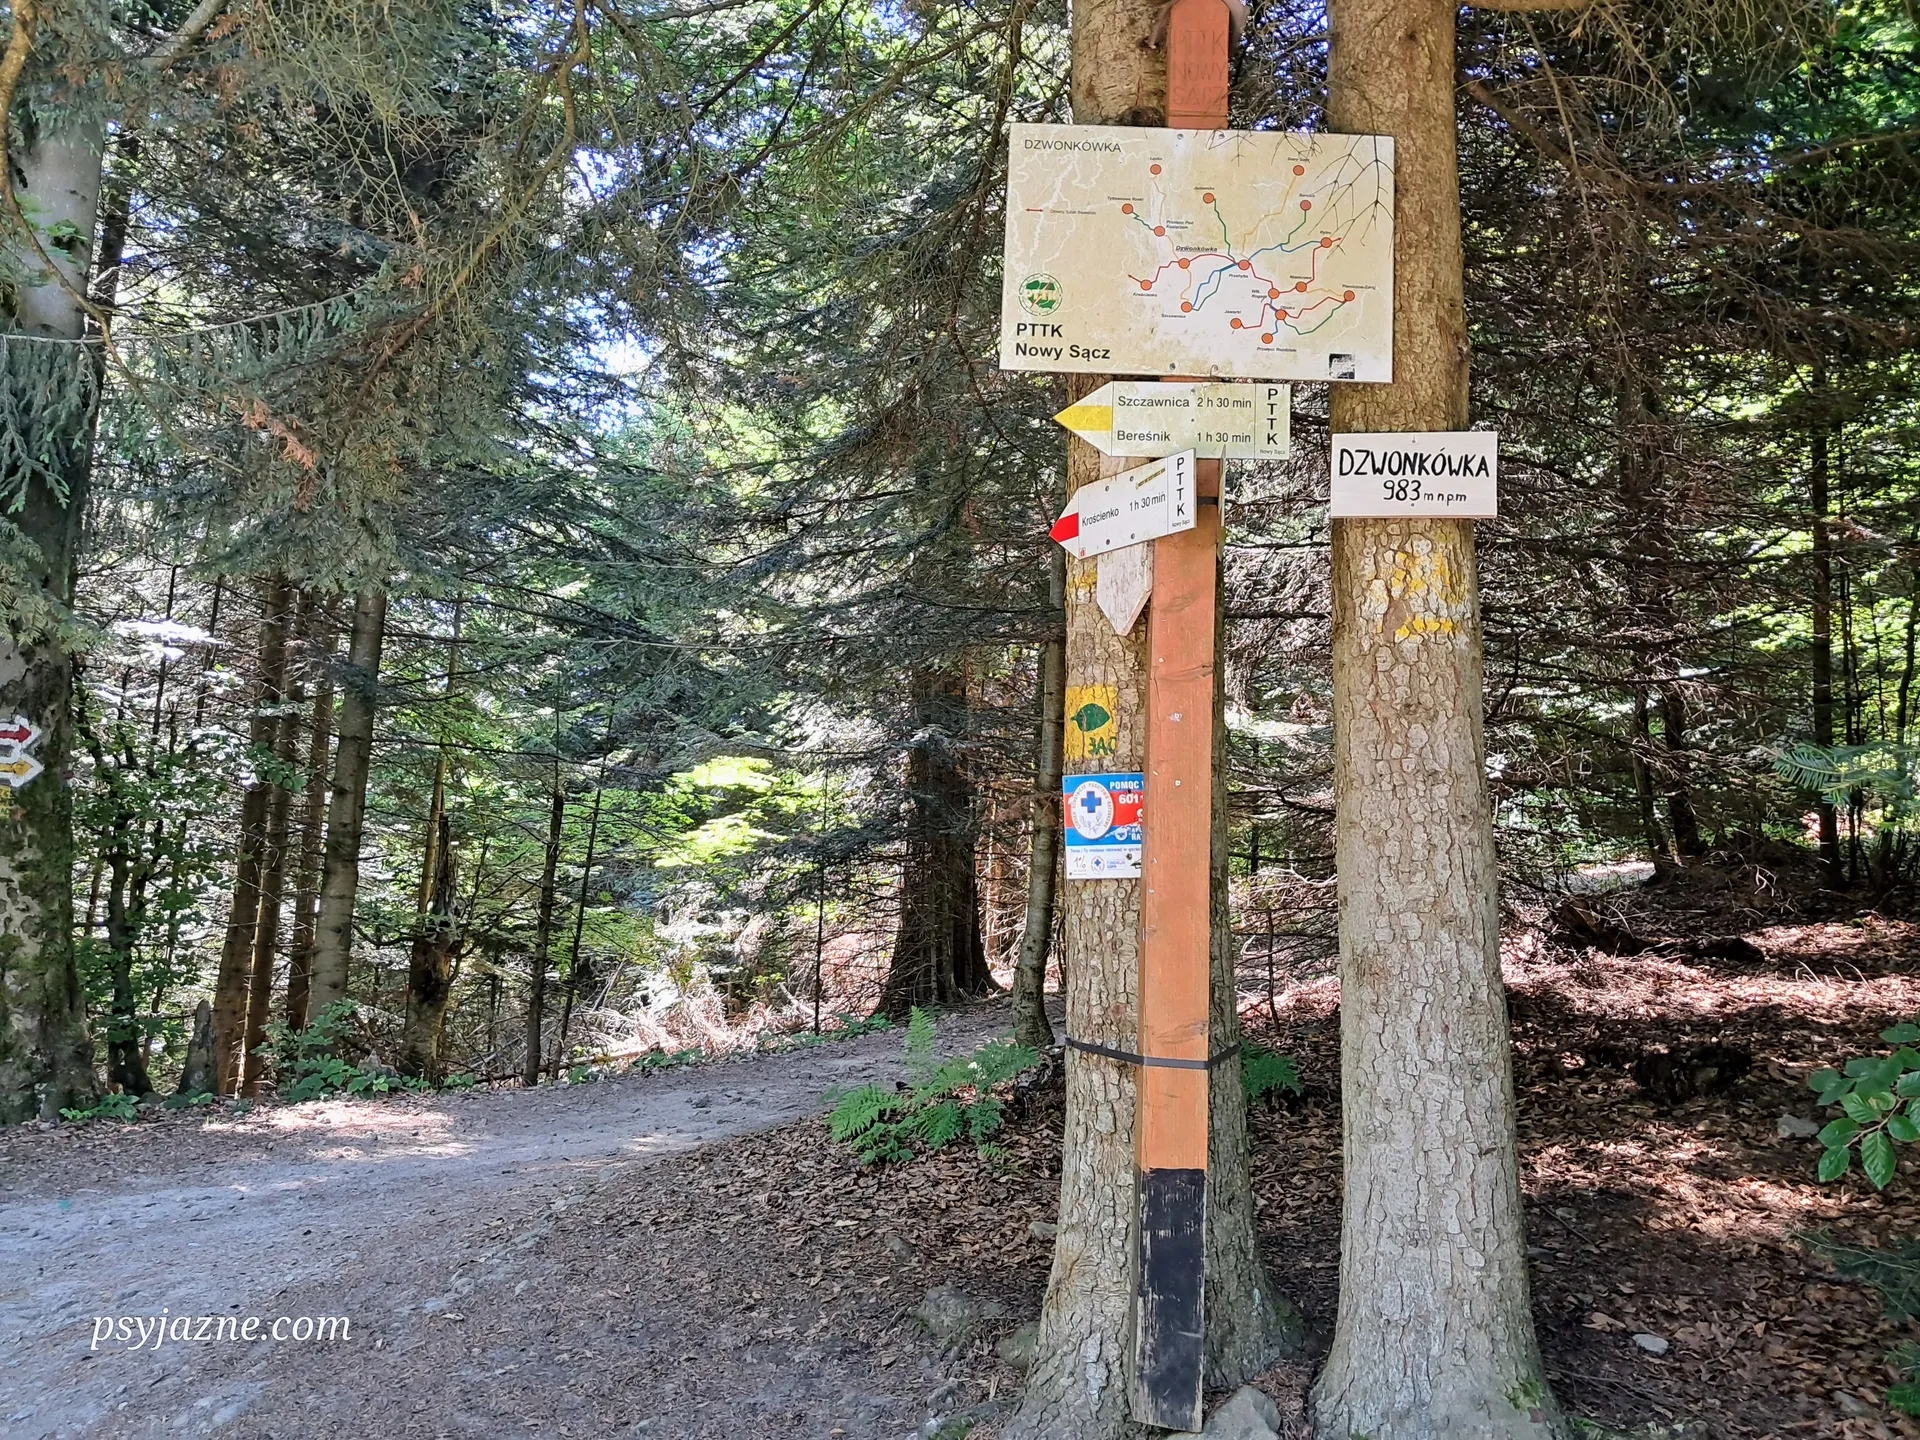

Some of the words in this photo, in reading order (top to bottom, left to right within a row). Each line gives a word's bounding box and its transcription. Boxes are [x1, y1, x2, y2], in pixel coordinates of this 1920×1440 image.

[1173, 29, 1226, 55] PTTK
[1173, 61, 1226, 81] NOWY
[1024, 139, 1122, 153] DZWONKÓWKA
[1016, 322, 1063, 338] PTTK
[1015, 343, 1063, 361] Nowy
[1069, 344, 1111, 361] Sącz
[1117, 396, 1190, 408] Szczawnica
[1197, 398, 1203, 408] 2
[1206, 398, 1213, 408] h
[1215, 398, 1229, 408] 30
[1232, 398, 1252, 408] min
[1266, 388, 1278, 445] PTTK
[1117, 430, 1171, 442] Bereśnik
[1197, 433, 1202, 442] 1
[1206, 433, 1213, 442] h
[1215, 433, 1229, 442] 30
[1232, 432, 1251, 443] min
[1339, 447, 1490, 478] DZWONKÓWKA
[1176, 457, 1185, 517] PTTK
[1383, 479, 1422, 501] 983
[1423, 492, 1434, 501] m
[1082, 508, 1119, 527] Krościenko
[1129, 502, 1133, 511] 1
[1134, 500, 1140, 510] h
[1141, 497, 1151, 508] 30
[1109, 780, 1139, 790] POMOC
[1118, 794, 1139, 804] 601
